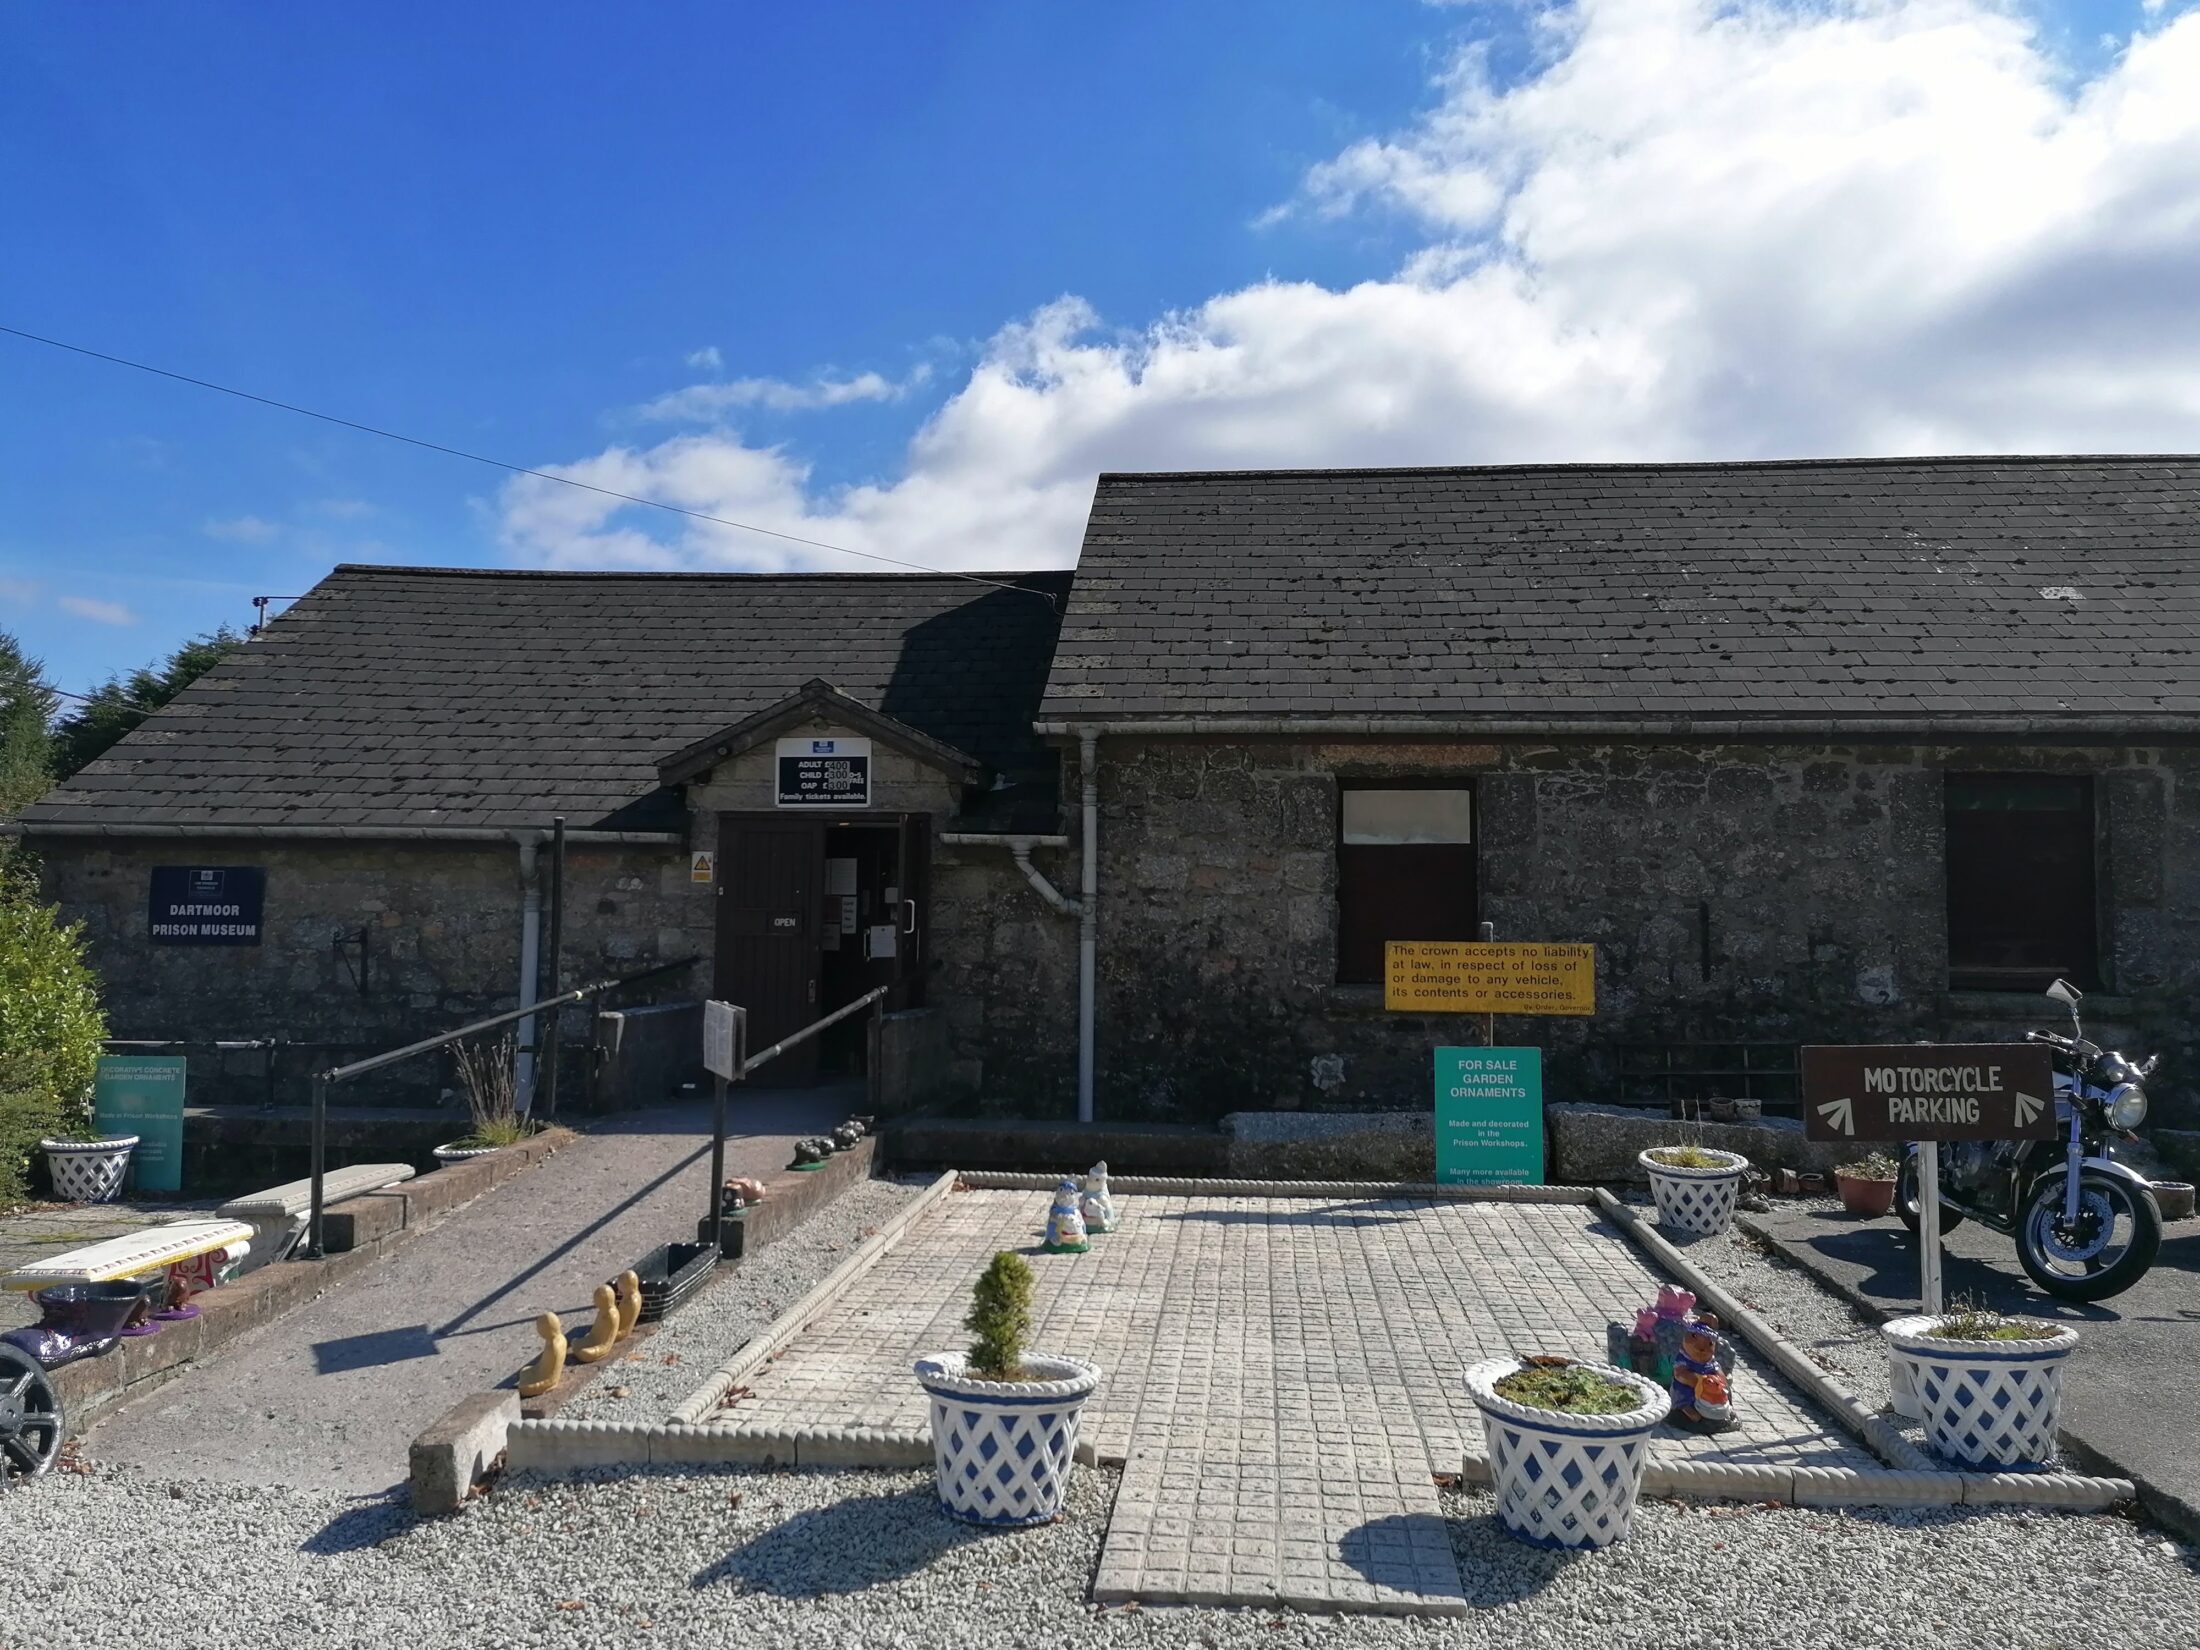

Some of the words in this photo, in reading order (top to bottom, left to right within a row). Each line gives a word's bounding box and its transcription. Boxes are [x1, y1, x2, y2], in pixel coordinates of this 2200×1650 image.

[170, 904, 240, 916] DARTMOOR
[774, 918, 796, 927] OPEN
[152, 924, 198, 935] PRISON
[200, 924, 256, 936] MUSEUM
[1392, 946, 1414, 956] The
[1421, 947, 1459, 956] crown
[1464, 946, 1516, 959] accepts
[1522, 948, 1538, 956] no
[1544, 946, 1590, 960] liability
[1392, 960, 1404, 969] at
[1440, 960, 1451, 969] in
[1457, 961, 1505, 973] respect
[1512, 960, 1525, 970] of
[1531, 961, 1558, 971] loss
[1564, 961, 1577, 971] of
[1392, 975, 1405, 983] or
[1411, 974, 1461, 986] damage
[1468, 975, 1480, 984] to
[1486, 976, 1509, 987] any
[1515, 975, 1563, 986] vehicle,
[1392, 988, 1408, 997] its
[1414, 989, 1469, 998] contents
[1475, 990, 1488, 998] or
[1494, 990, 1576, 1000] accessories.
[1458, 1060, 1483, 1070] FOR
[1486, 1060, 1518, 1070] SALE
[1462, 1074, 1514, 1084] GARDEN
[1864, 1066, 2004, 1093] MOTORCYCLE
[1450, 1088, 1526, 1098] ORNAMENTS
[1888, 1097, 1980, 1124] PARKING
[1448, 1120, 1470, 1128] Made
[1472, 1120, 1487, 1128] and
[1488, 1120, 1530, 1128] decorated
[1453, 1139, 1479, 1147] Prison
[1481, 1139, 1528, 1148] Workshops.
[1450, 1168, 1470, 1176] Many
[1494, 1168, 1530, 1176] available
